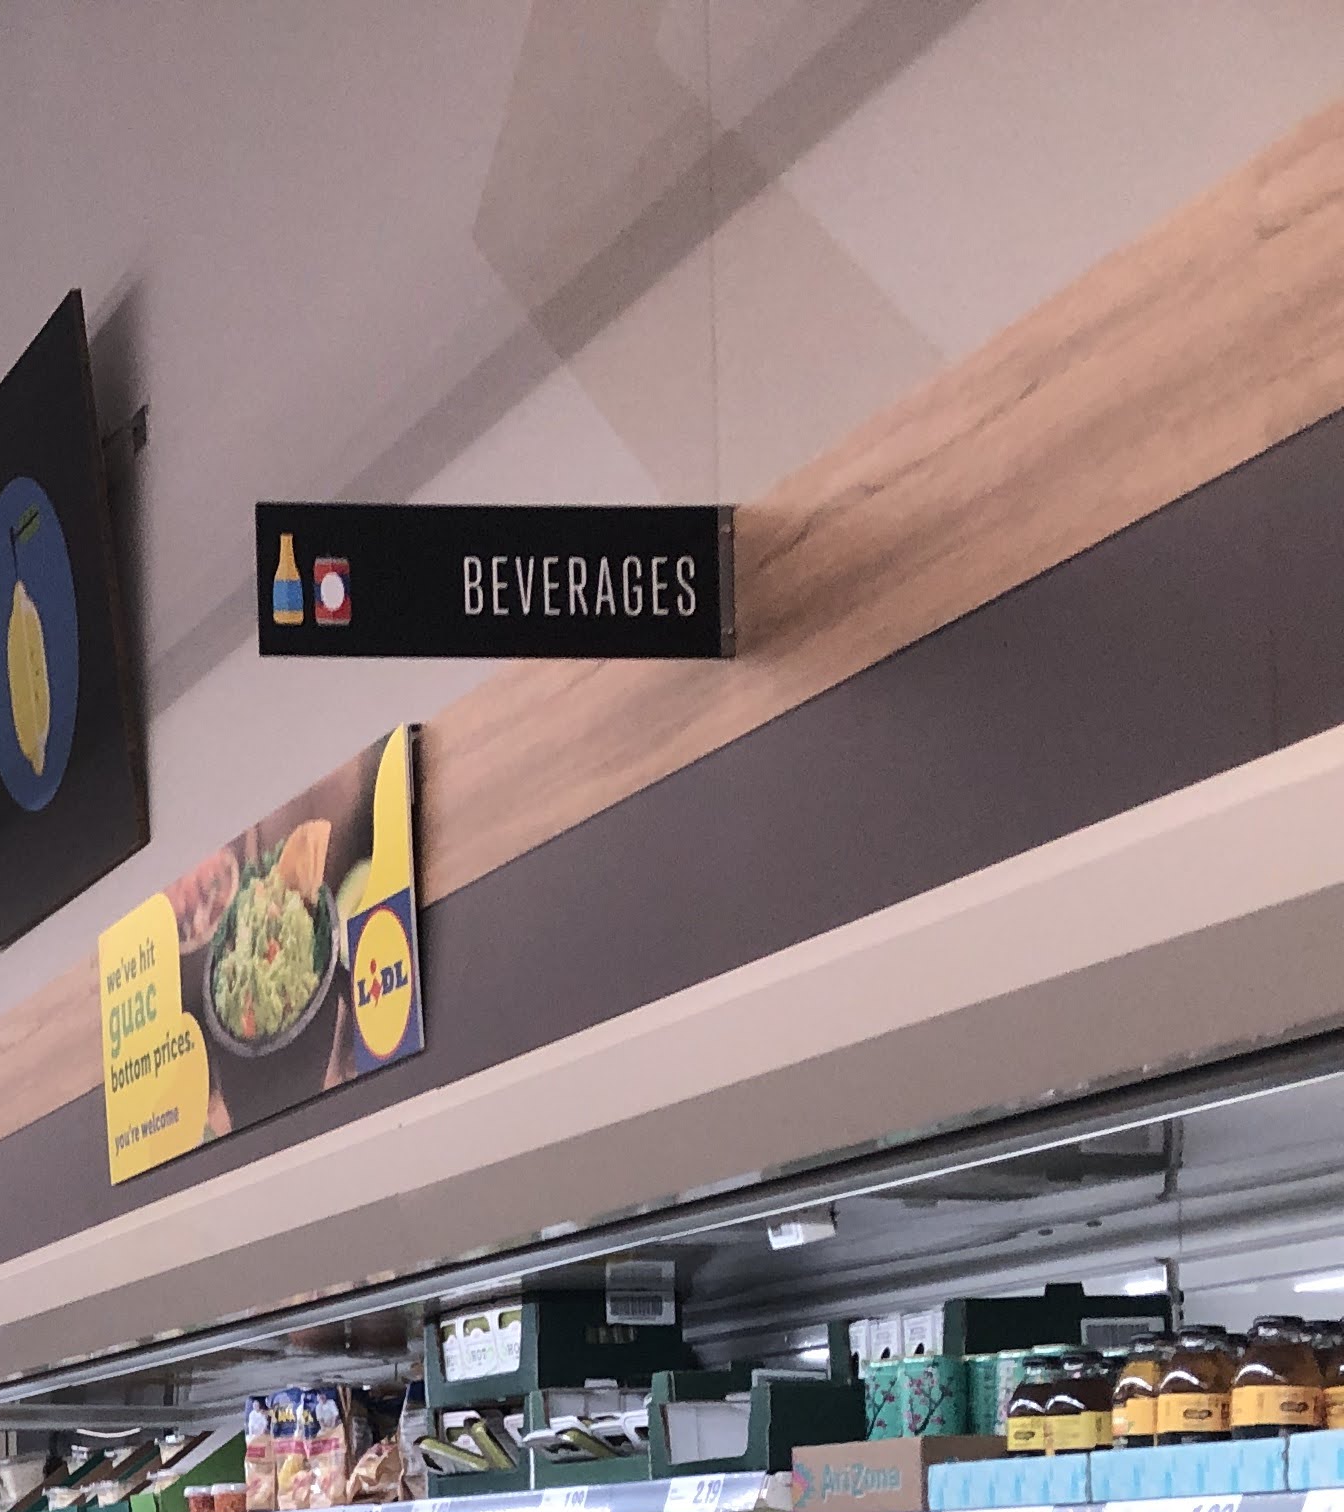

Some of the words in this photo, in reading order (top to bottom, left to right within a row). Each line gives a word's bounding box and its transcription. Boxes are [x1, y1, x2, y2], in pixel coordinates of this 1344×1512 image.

[463, 555, 697, 617] BEVERAGES
[138, 938, 156, 974] hit
[108, 983, 158, 1060] guac
[110, 1052, 152, 1094] bottom
[153, 1030, 196, 1080] prices.
[141, 1105, 180, 1138] welcome
[821, 1461, 900, 1498] AriZona
